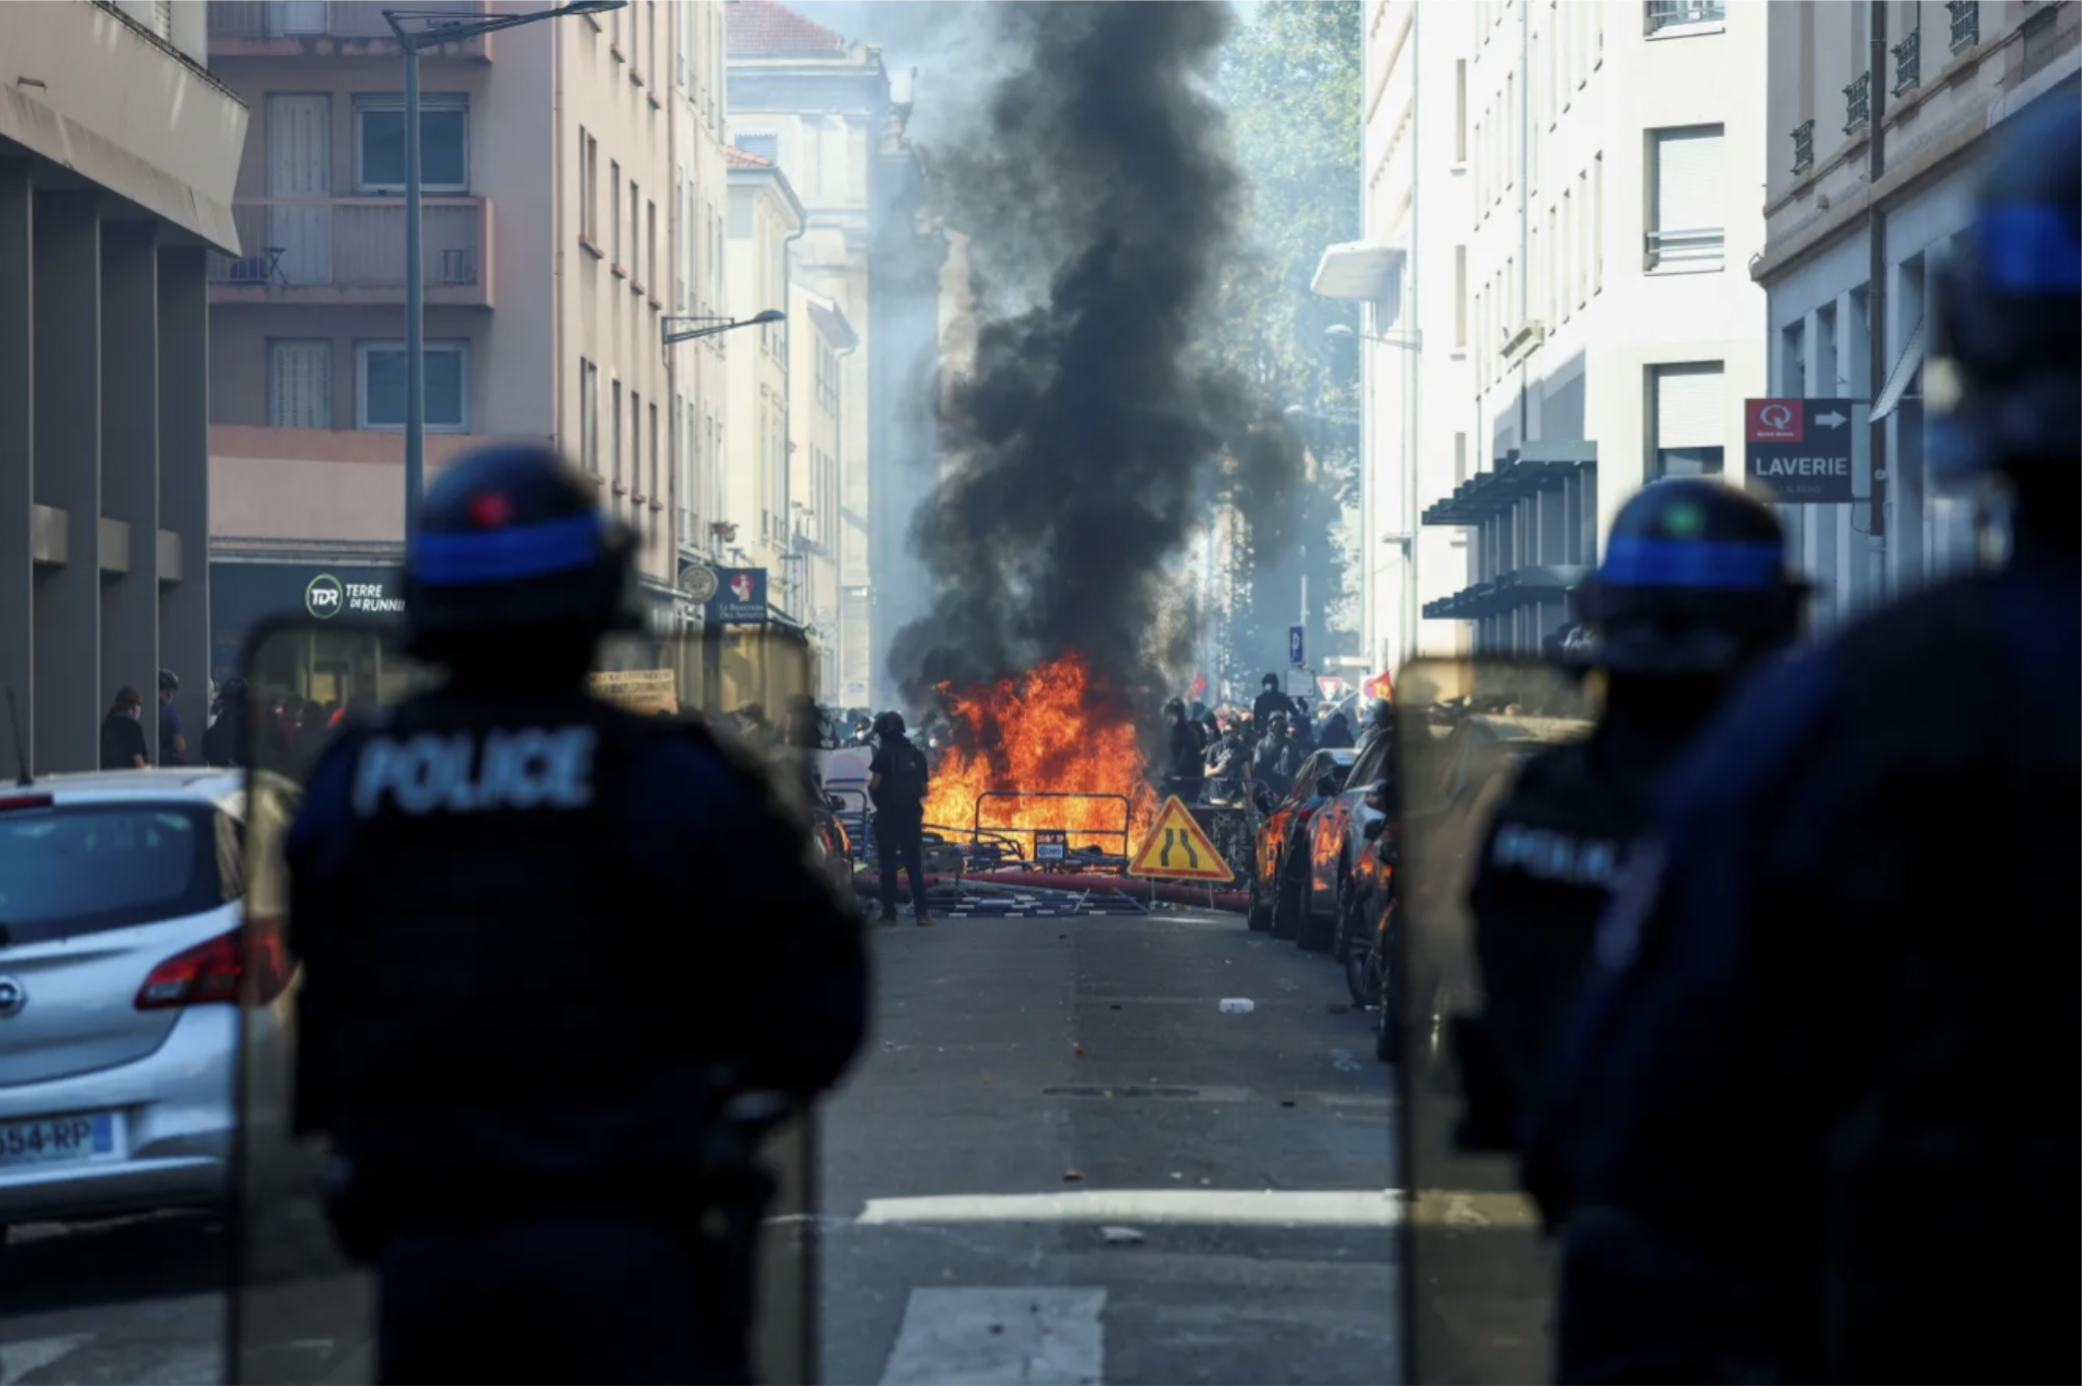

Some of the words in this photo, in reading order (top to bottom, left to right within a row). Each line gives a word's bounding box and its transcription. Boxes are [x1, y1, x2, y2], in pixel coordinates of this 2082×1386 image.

[1755, 457, 1848, 476] LAVERIE
[311, 588, 339, 606] TDR
[346, 583, 383, 598] TERRE
[353, 724, 598, 816] POLICE
